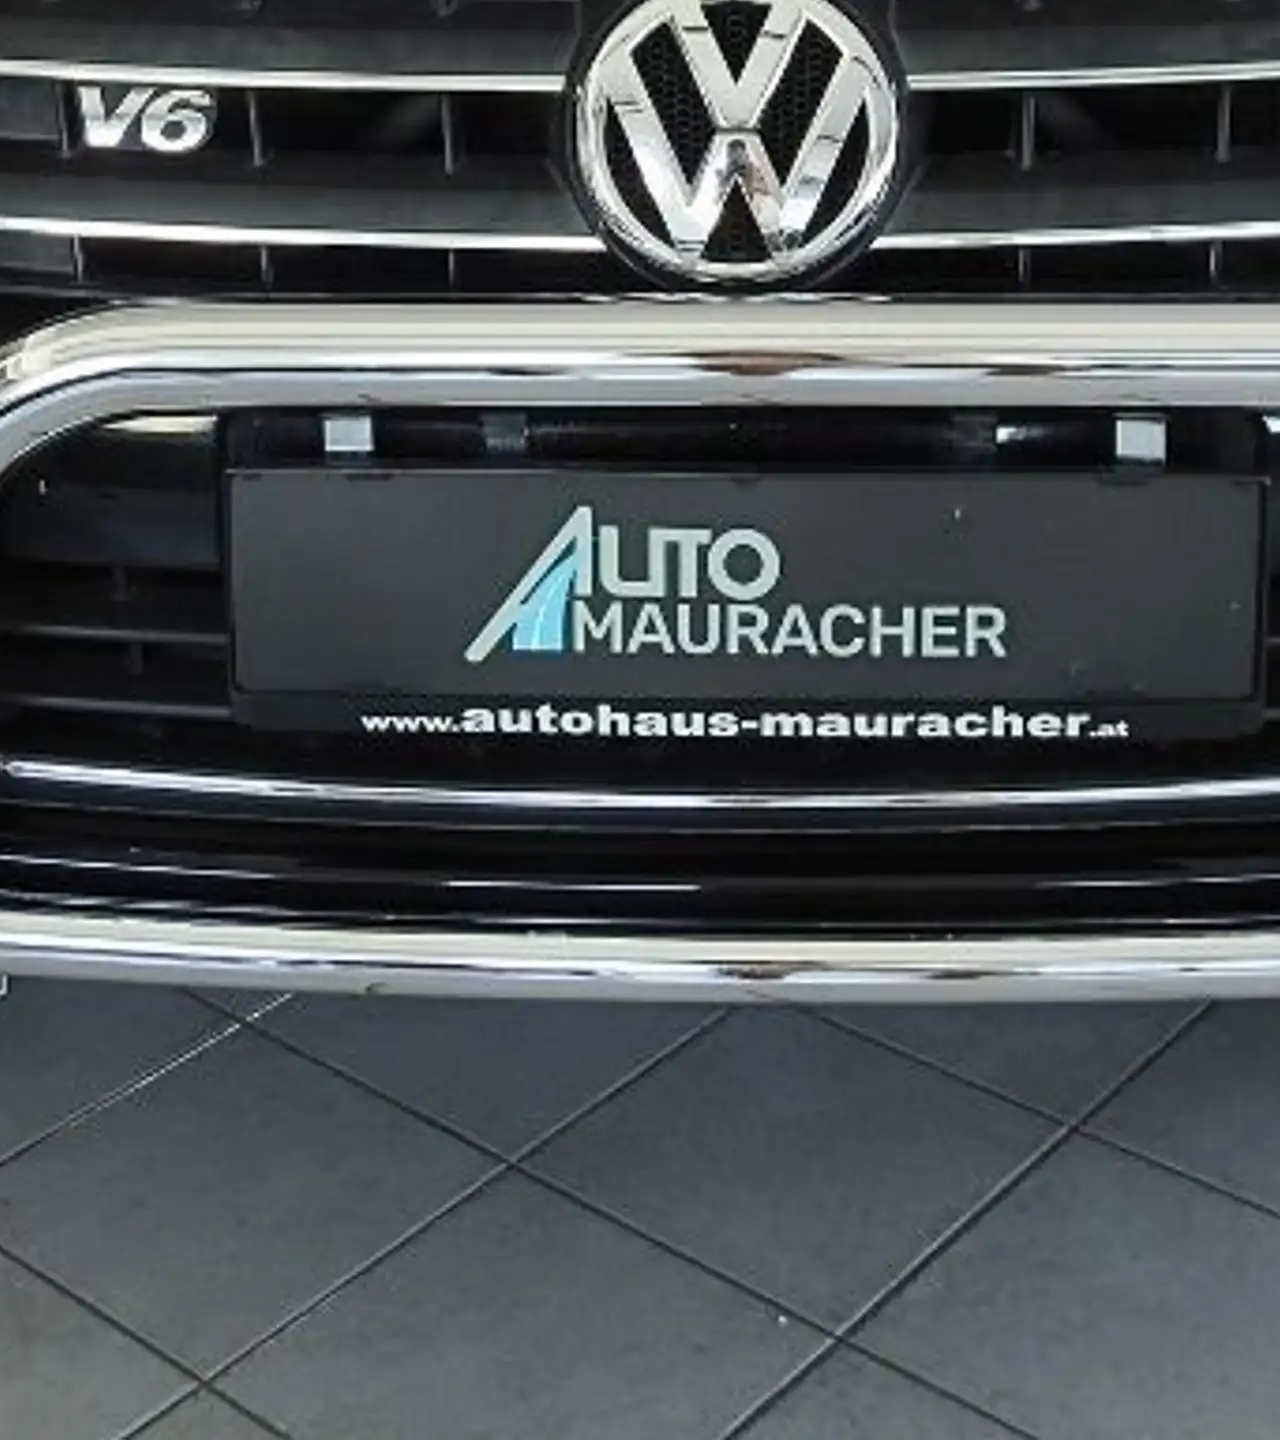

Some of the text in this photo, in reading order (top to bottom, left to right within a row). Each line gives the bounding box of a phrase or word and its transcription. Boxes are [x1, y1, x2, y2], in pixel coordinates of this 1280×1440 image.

[77, 86, 211, 152] V6
[463, 505, 781, 662] AUTO
[572, 599, 1008, 659] MAURACHER
[360, 702, 1130, 738] www.autohaus-mauracher.at
